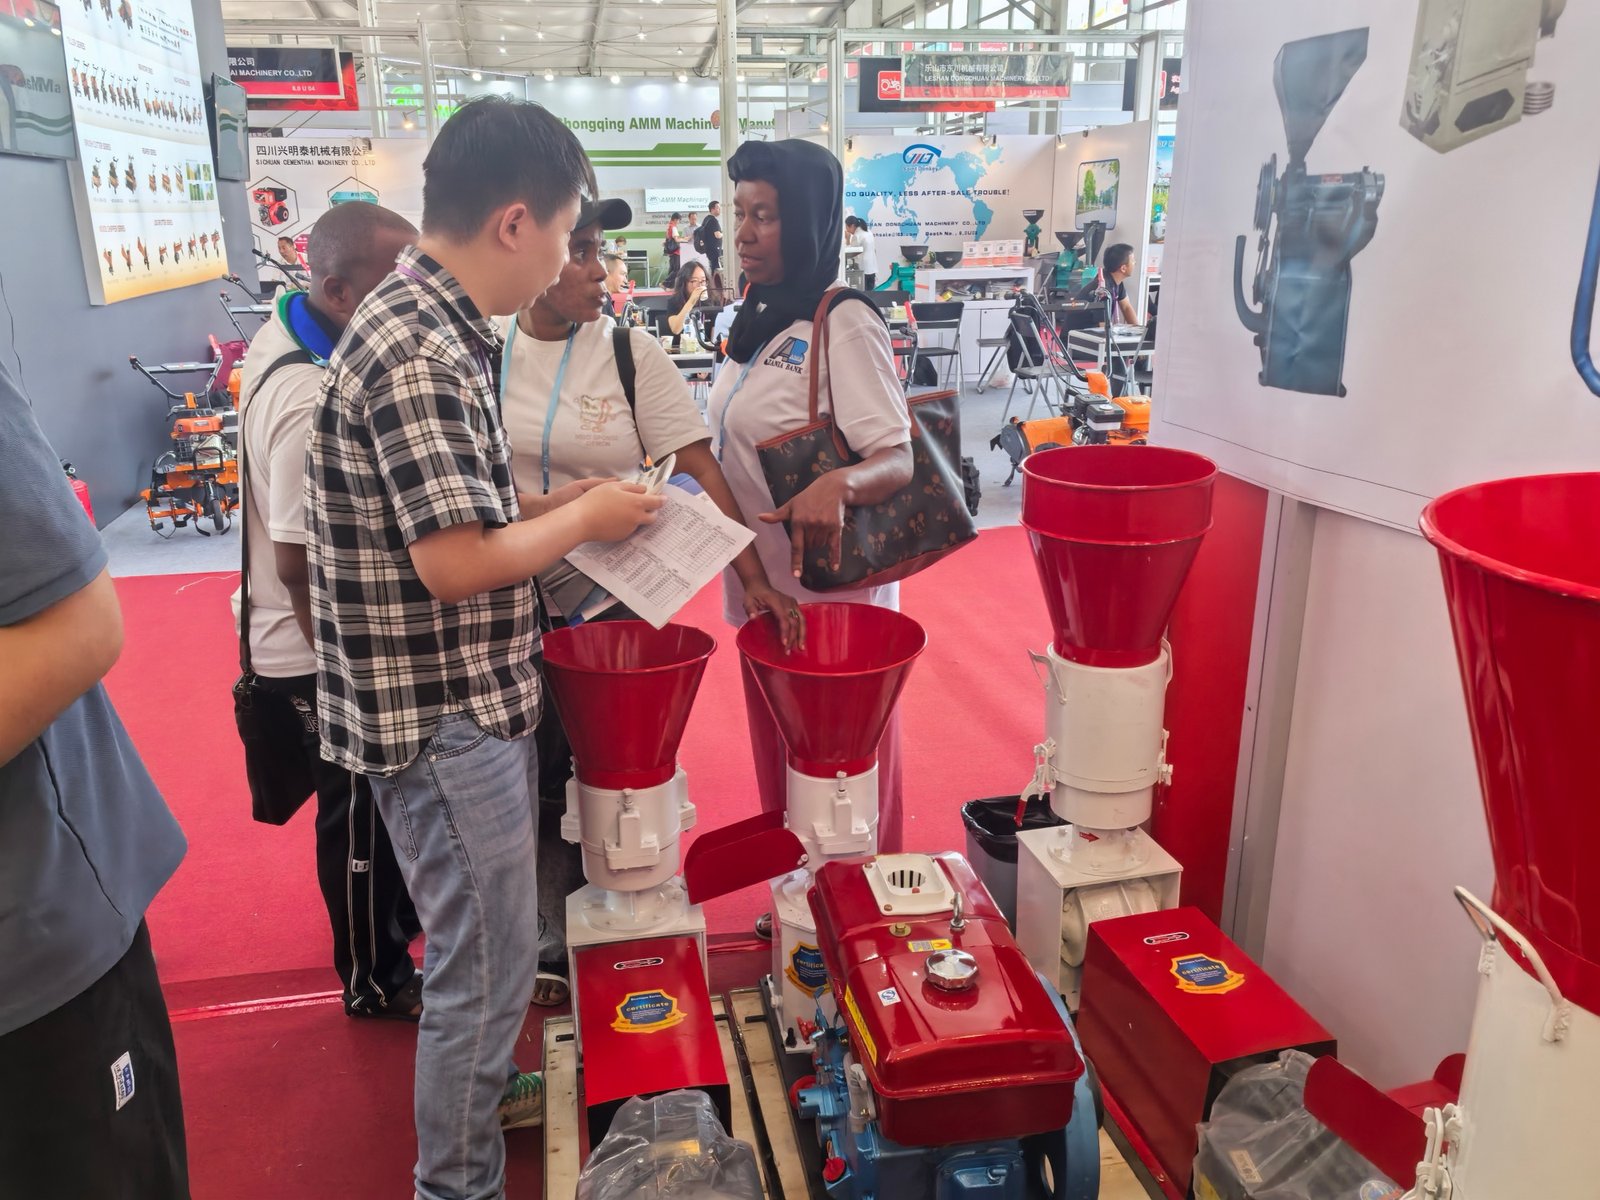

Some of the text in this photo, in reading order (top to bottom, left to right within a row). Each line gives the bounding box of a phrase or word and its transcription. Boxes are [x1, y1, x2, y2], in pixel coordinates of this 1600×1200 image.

[629, 117, 661, 130] AMM
[256, 145, 371, 156] 四川兴明泰机械有限公司
[921, 189, 970, 197] AFTER-SALE
[974, 188, 1011, 196] TROUBLE!
[763, 358, 803, 375] AZANIA BANK
[1181, 964, 1221, 976] certificate
[626, 1001, 669, 1013] certificate
